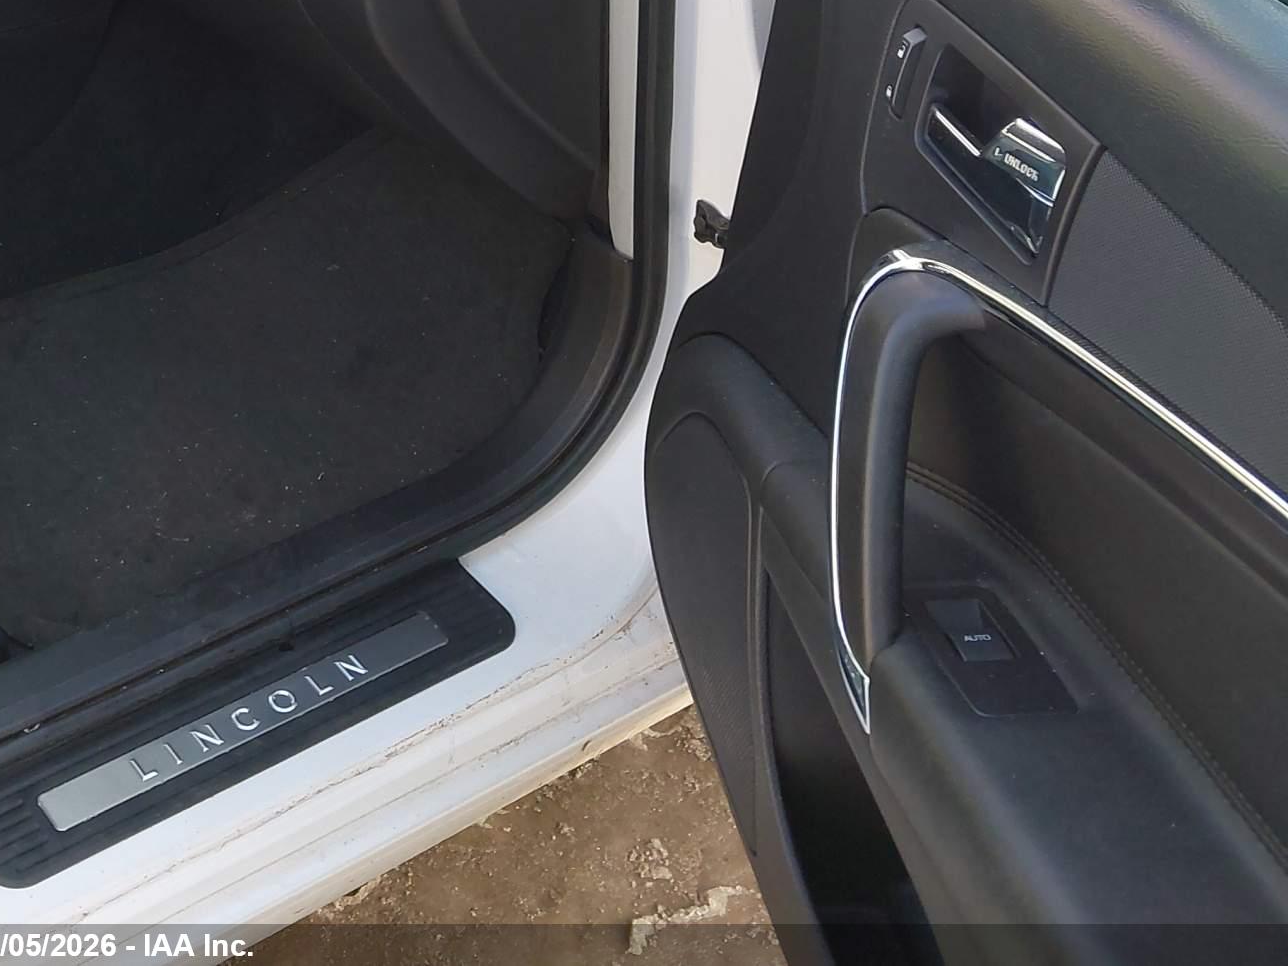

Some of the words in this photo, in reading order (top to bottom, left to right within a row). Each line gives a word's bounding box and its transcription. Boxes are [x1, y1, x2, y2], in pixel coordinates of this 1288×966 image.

[1004, 153, 1040, 181] UNLOCK
[963, 633, 992, 642] AUTO
[129, 654, 369, 782] LINCOLN
